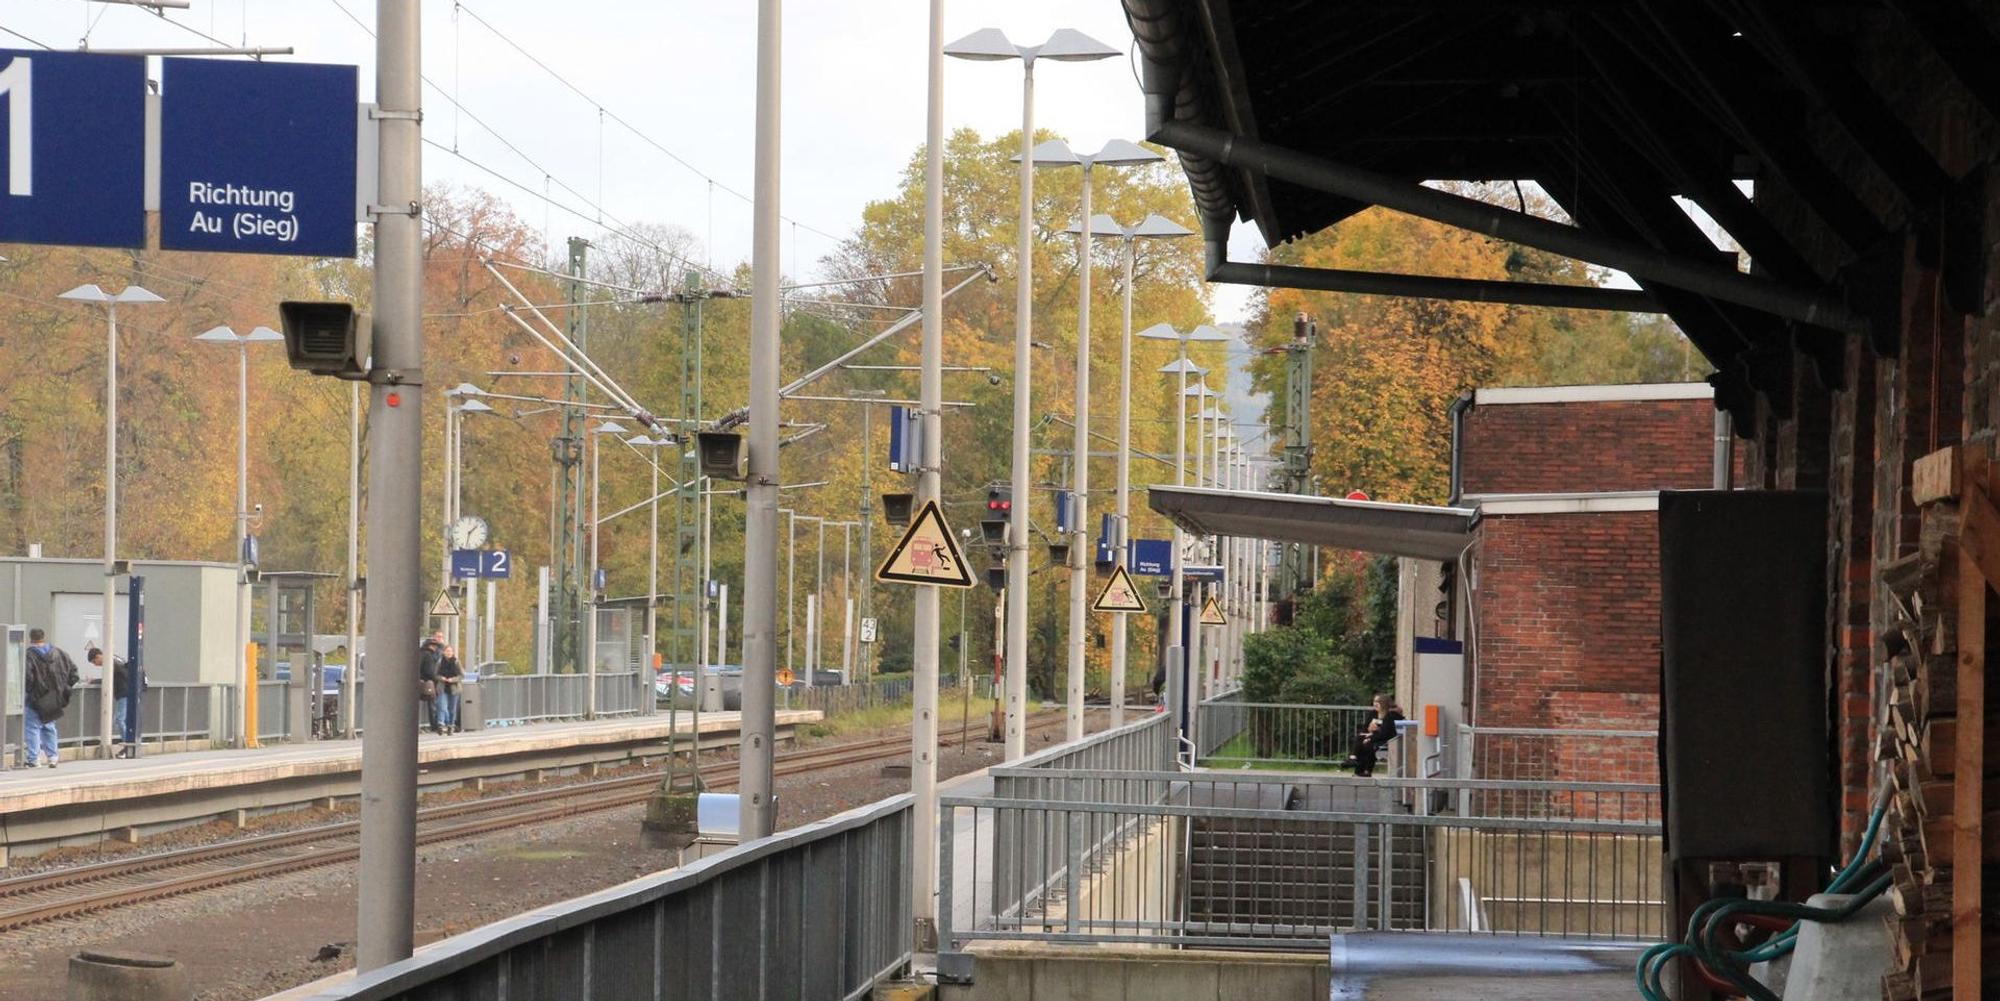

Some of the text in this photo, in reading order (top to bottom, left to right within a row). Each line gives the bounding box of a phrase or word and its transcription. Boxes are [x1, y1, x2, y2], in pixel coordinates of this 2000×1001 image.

[0, 56, 32, 196] 1
[189, 181, 294, 213] Richtung
[189, 211, 299, 242] Au (Sieg)
[491, 551, 507, 572] 2
[863, 619, 876, 630] 43
[864, 630, 873, 640] 2
